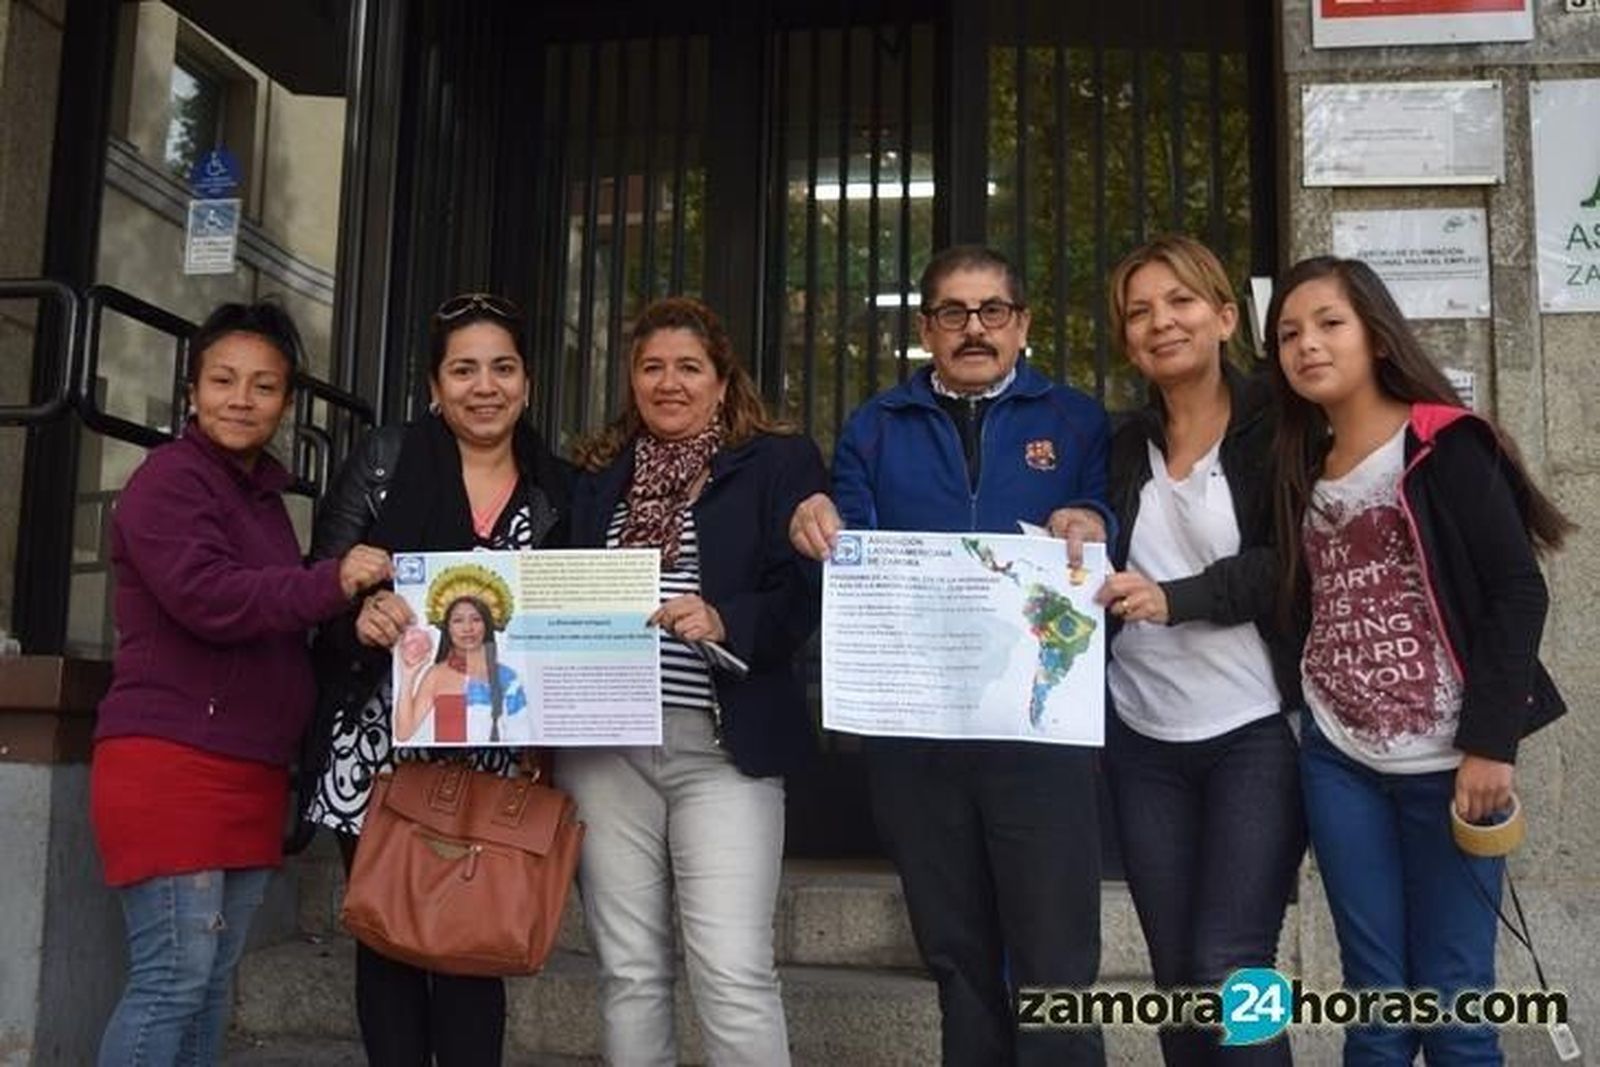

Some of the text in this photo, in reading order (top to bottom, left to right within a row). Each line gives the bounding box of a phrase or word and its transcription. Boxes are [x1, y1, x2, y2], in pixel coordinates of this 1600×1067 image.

[1566, 264, 1600, 286] ZA
[882, 557, 920, 567] ZAMORA
[1321, 545, 1351, 568] MY
[1320, 561, 1387, 594] EART
[1330, 598, 1352, 617] IS
[1315, 613, 1412, 643] EATING
[1333, 637, 1419, 667] HARD
[1355, 661, 1424, 686] YOU
